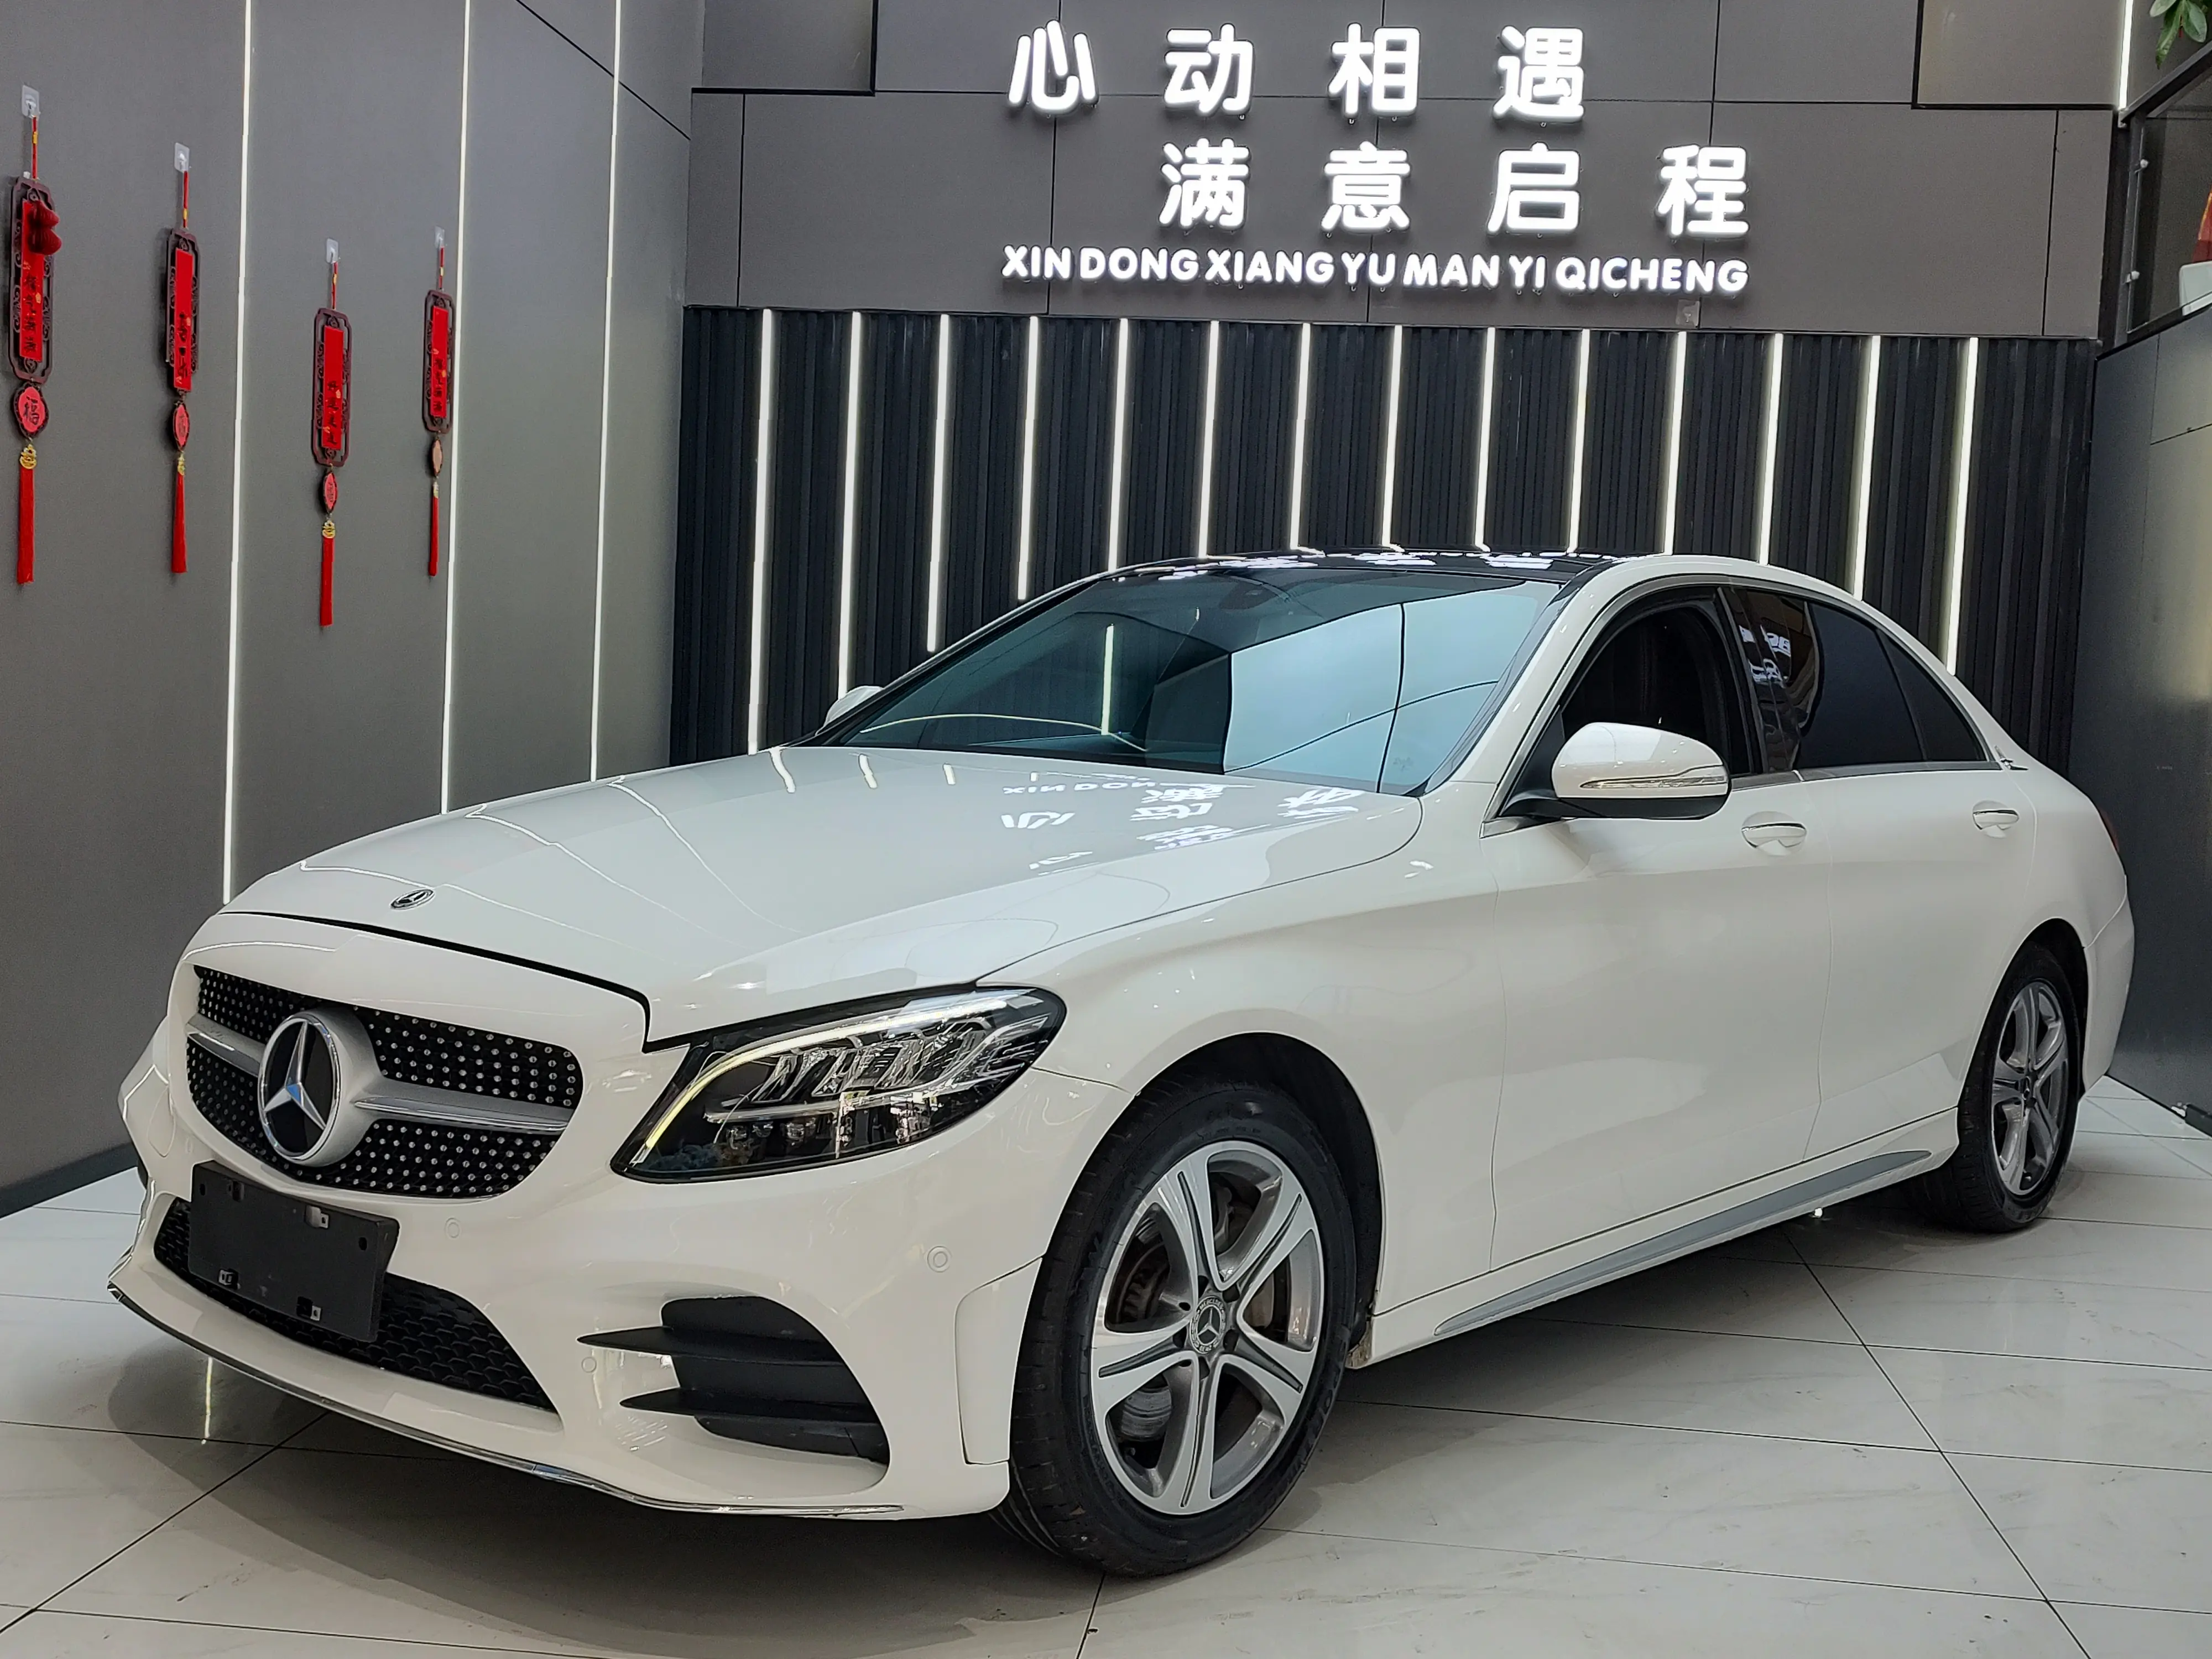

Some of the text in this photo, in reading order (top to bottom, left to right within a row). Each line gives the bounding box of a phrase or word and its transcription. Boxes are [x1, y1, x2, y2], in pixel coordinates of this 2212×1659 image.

[1008, 19, 1584, 122] 心动相遇
[1159, 137, 1749, 236] 满意启程
[1001, 245, 1749, 293] XIN DONG XIANG YU MAN YI QICHENG
[24, 395, 40, 426] 福
